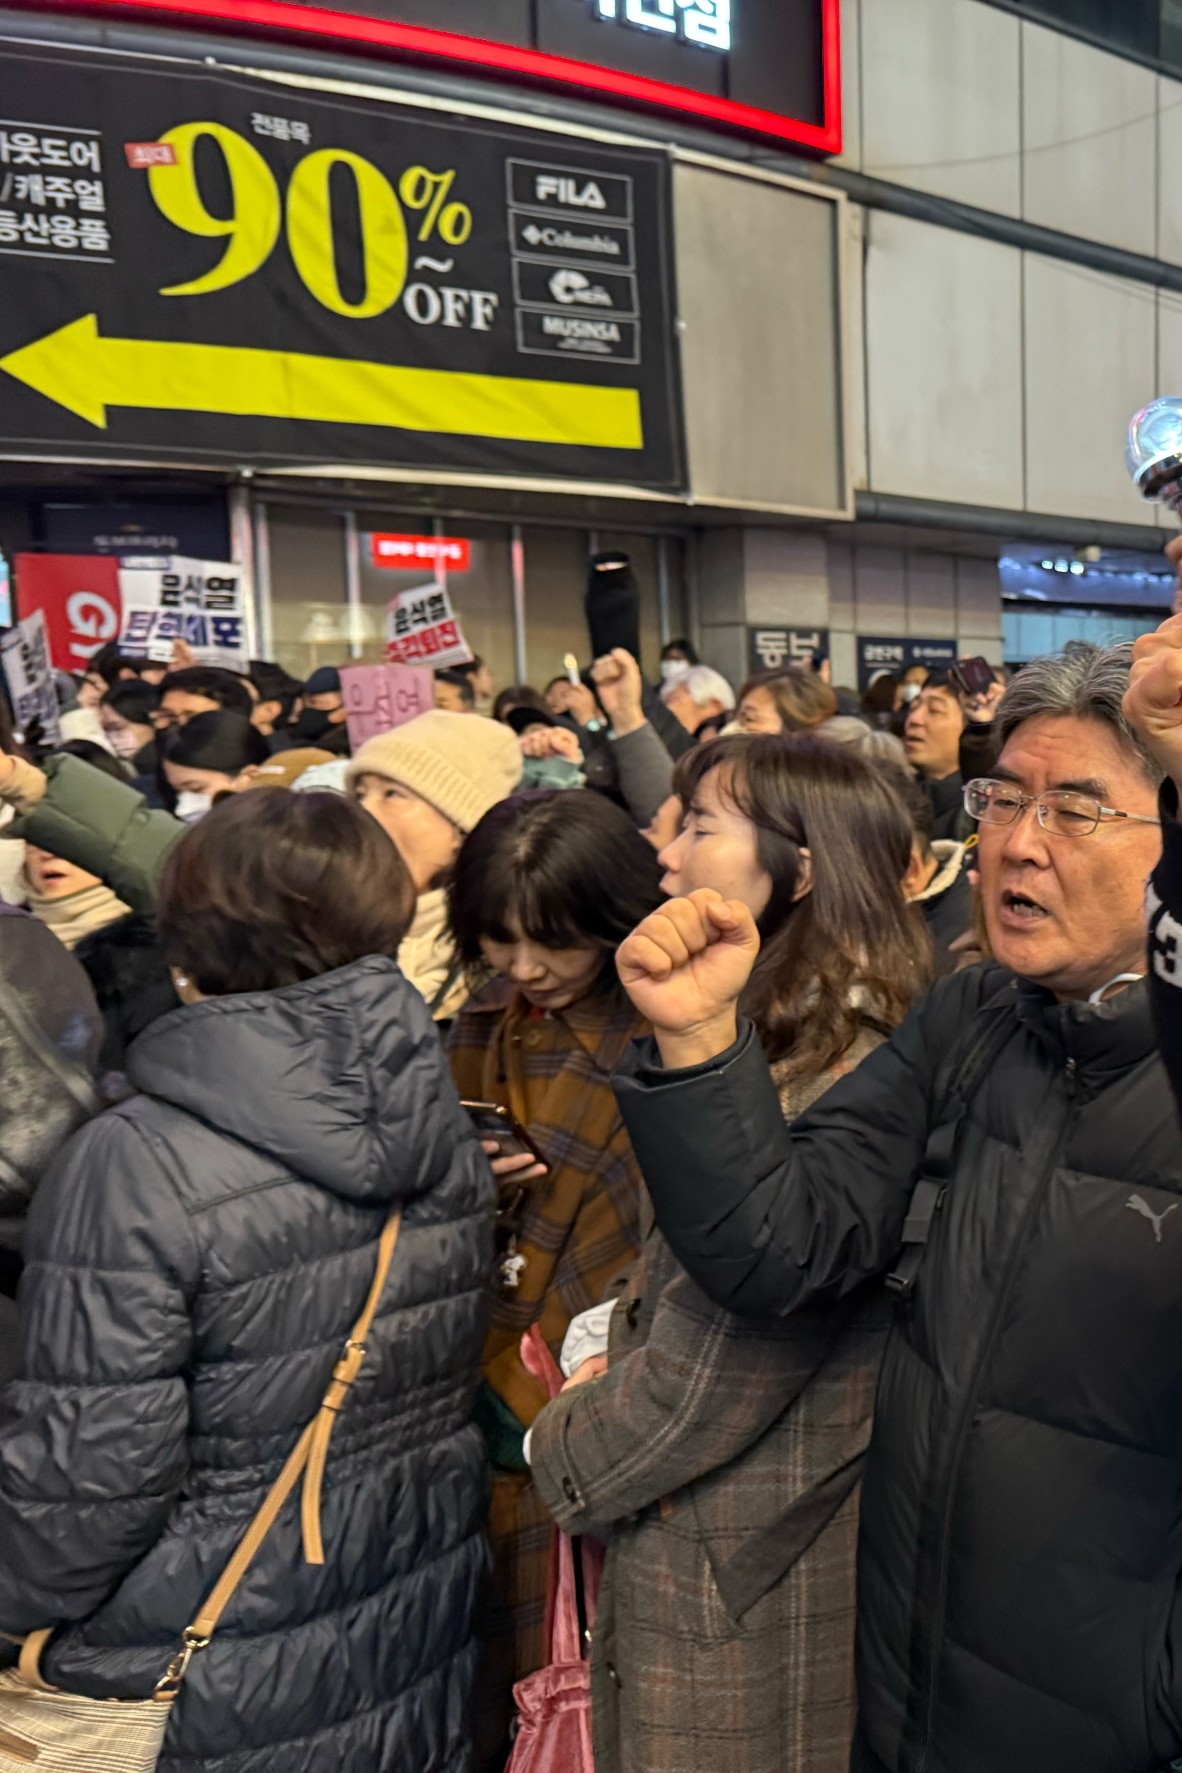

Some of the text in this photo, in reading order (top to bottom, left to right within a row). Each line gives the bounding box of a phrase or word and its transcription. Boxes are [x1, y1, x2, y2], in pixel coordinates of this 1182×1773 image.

[251, 112, 311, 145] 전품목
[535, 174, 607, 210] FILA
[0, 210, 110, 250] 등산용품
[541, 227, 621, 255] Columbia
[403, 282, 499, 331] OFF
[542, 315, 622, 342] MUSINSA
[394, 592, 448, 635] 윤석열
